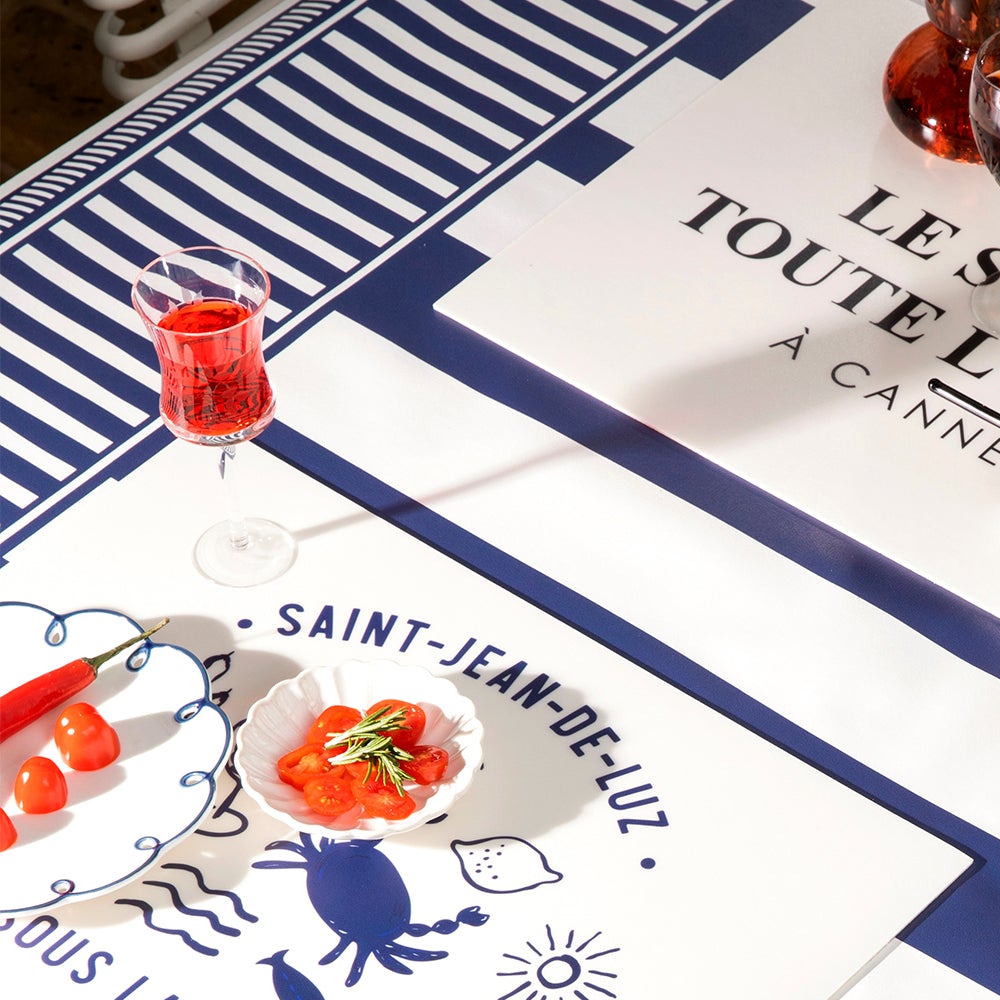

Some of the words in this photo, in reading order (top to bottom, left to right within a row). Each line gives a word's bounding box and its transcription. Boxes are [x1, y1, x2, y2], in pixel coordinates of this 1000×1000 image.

[838, 185, 961, 261] LE
[678, 187, 946, 344] TOUTE
[769, 326, 810, 360] À
[277, 603, 670, 835] SAINT-JEAN-DE-LUZ
[0, 915, 114, 984] OUS
